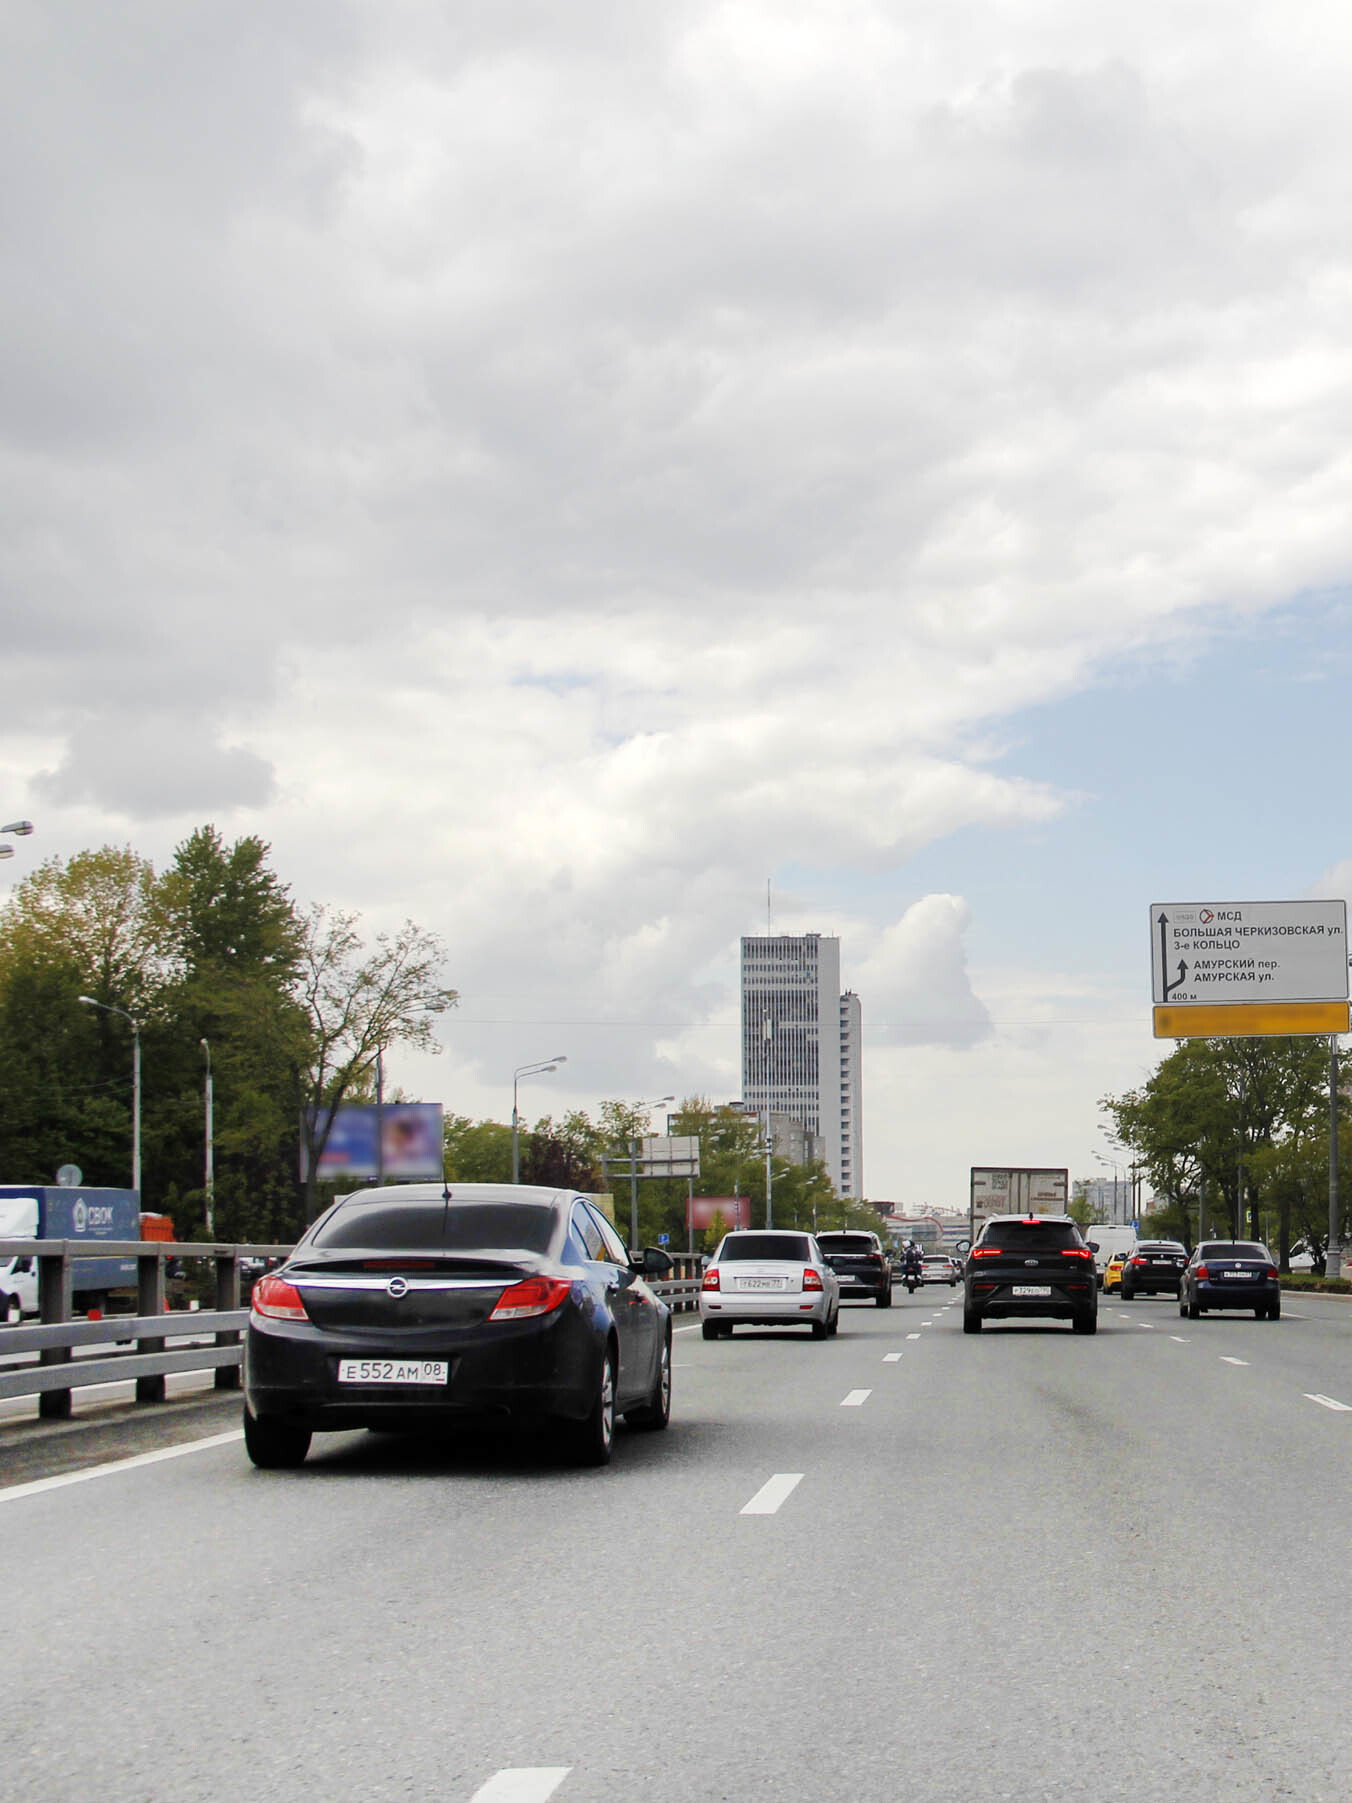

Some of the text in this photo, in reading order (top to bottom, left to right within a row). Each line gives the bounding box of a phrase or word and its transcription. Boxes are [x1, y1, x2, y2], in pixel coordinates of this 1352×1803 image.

[1217, 911, 1242, 921] МСД
[1173, 925, 1343, 937] БОЛЬШАЯ ЧЕРКИЗОВСКАЯ ул.
[1174, 940, 1240, 951] 3-е КОЛЬЦО
[1193, 958, 1280, 969] АМУРСКИЙ пер.
[1194, 972, 1274, 982] АМУРСКАЯ ул.
[347, 1363, 441, 1379] Е552АМ 08
